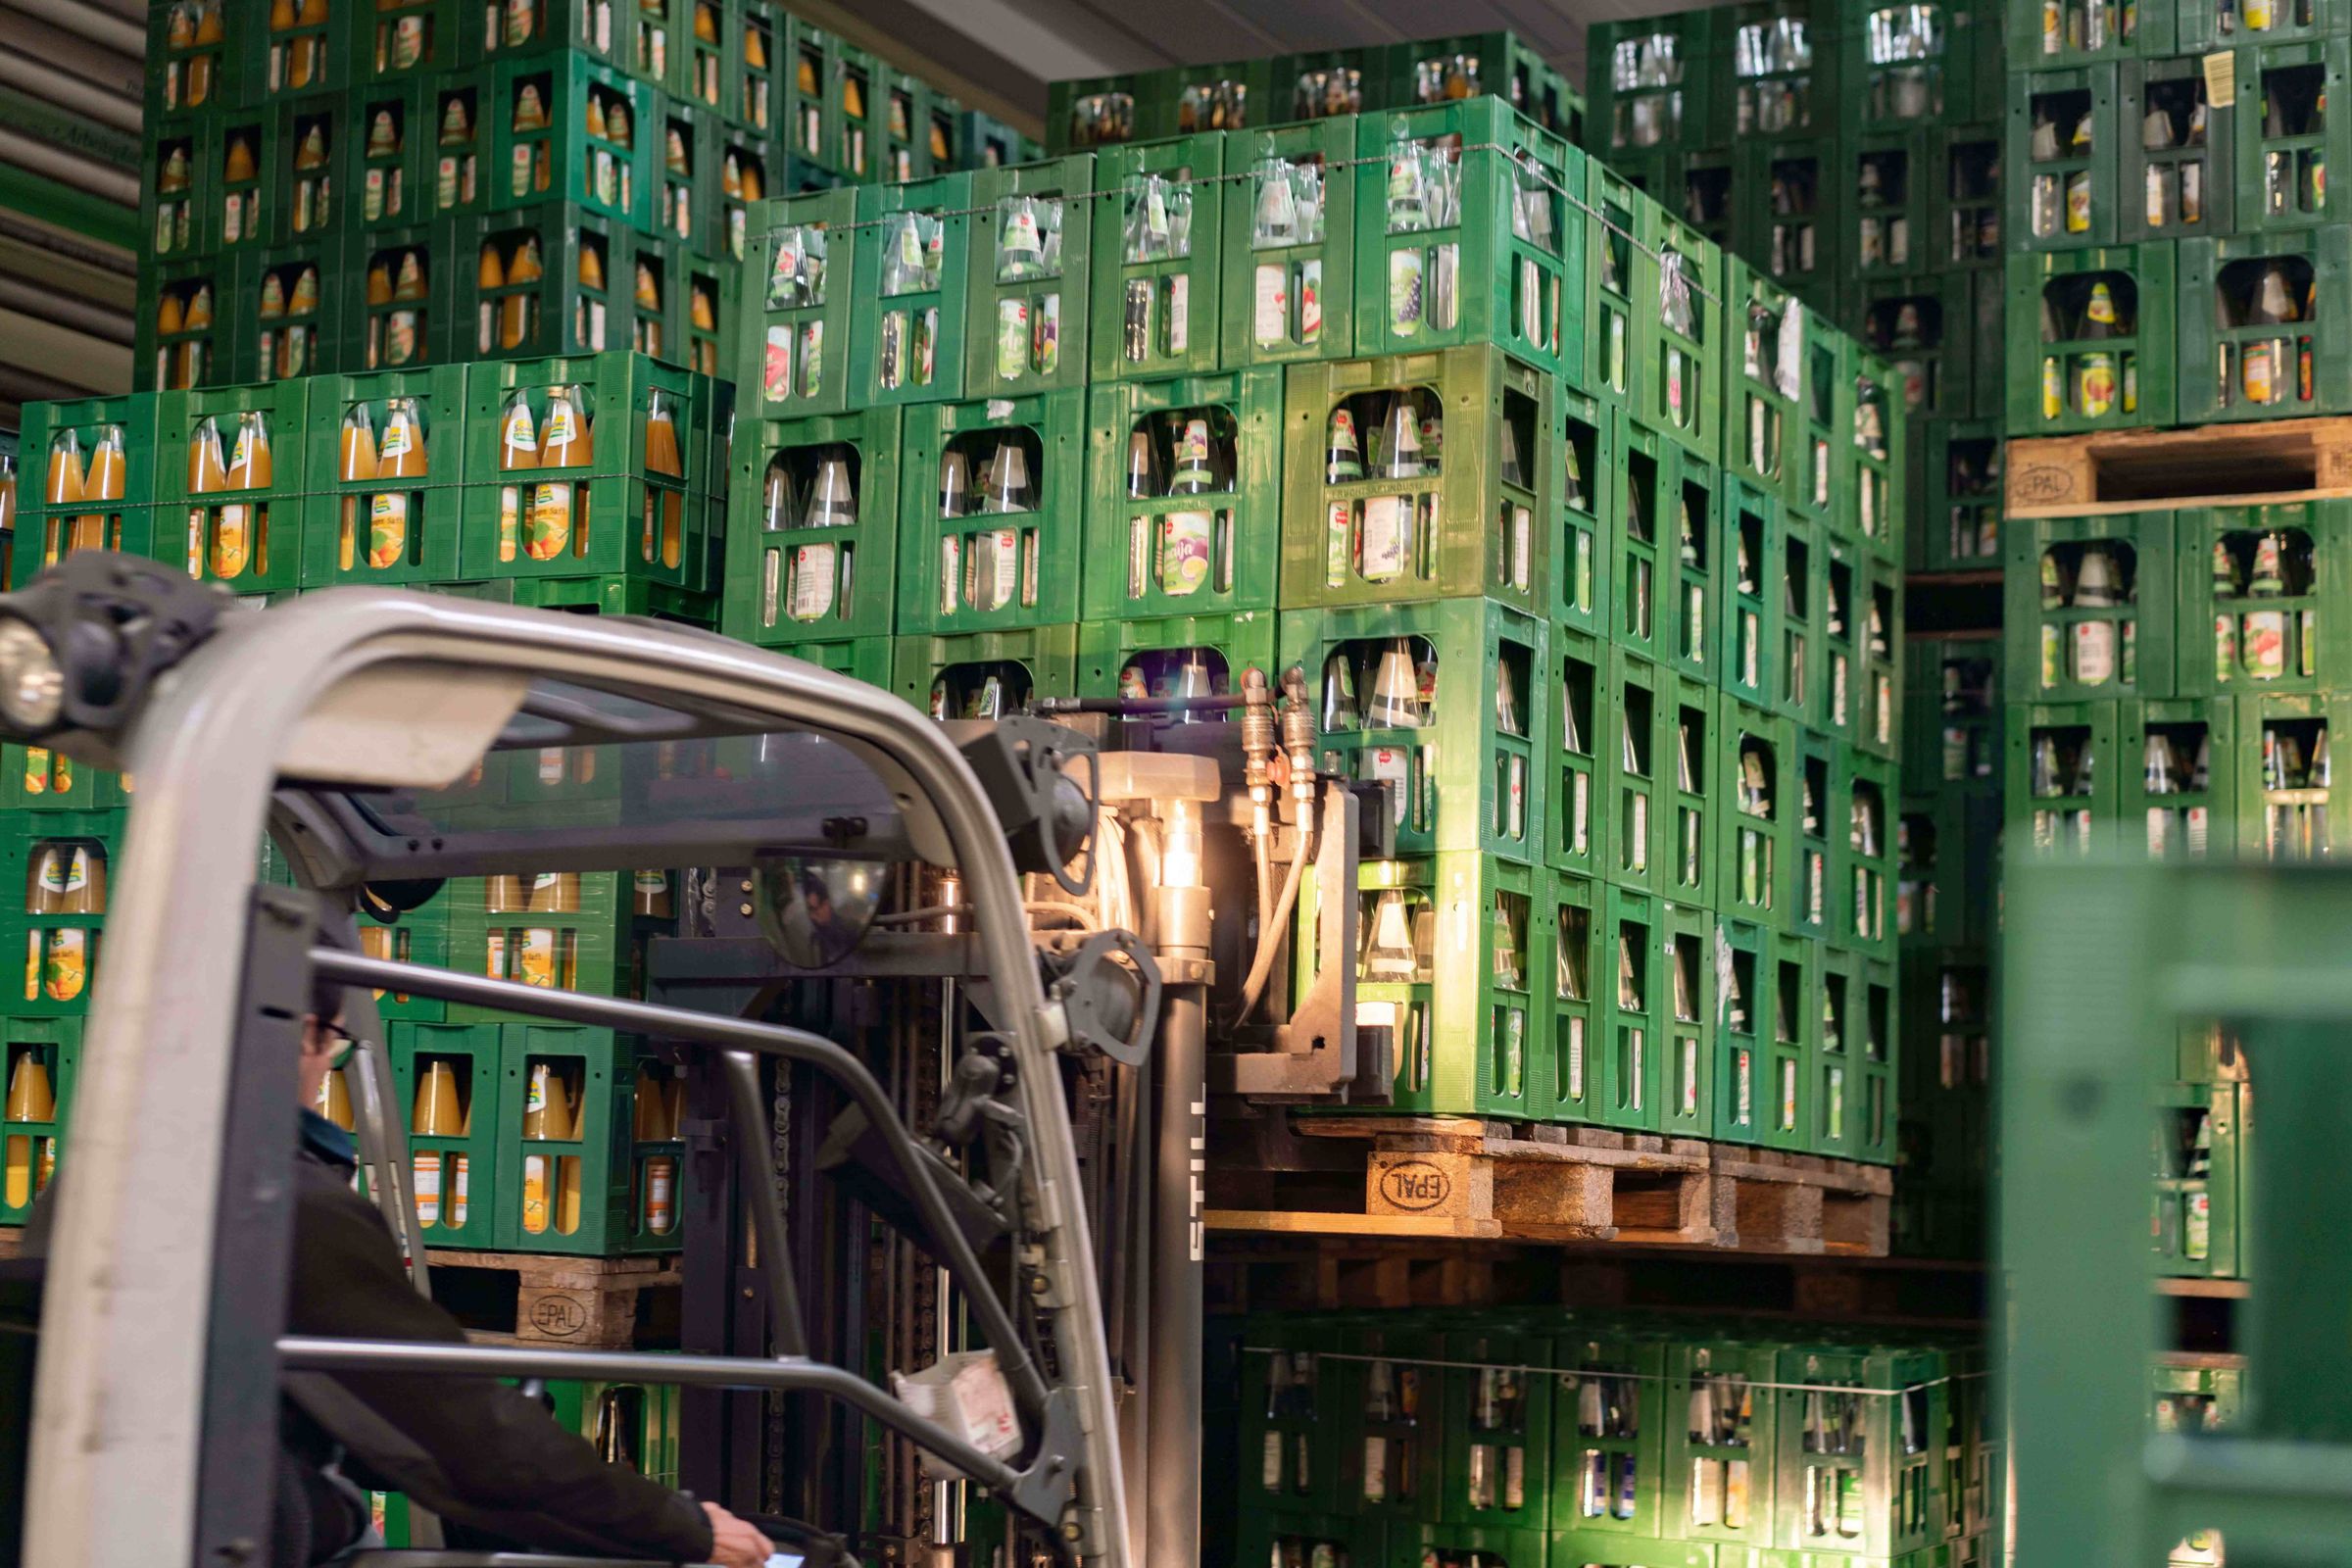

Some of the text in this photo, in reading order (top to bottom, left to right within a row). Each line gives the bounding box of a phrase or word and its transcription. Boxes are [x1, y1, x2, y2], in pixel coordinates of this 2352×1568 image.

[1190, 1082, 1206, 1261] STILL
[1392, 1173, 1442, 1199] EPAL
[538, 1302, 576, 1328] EPAL
